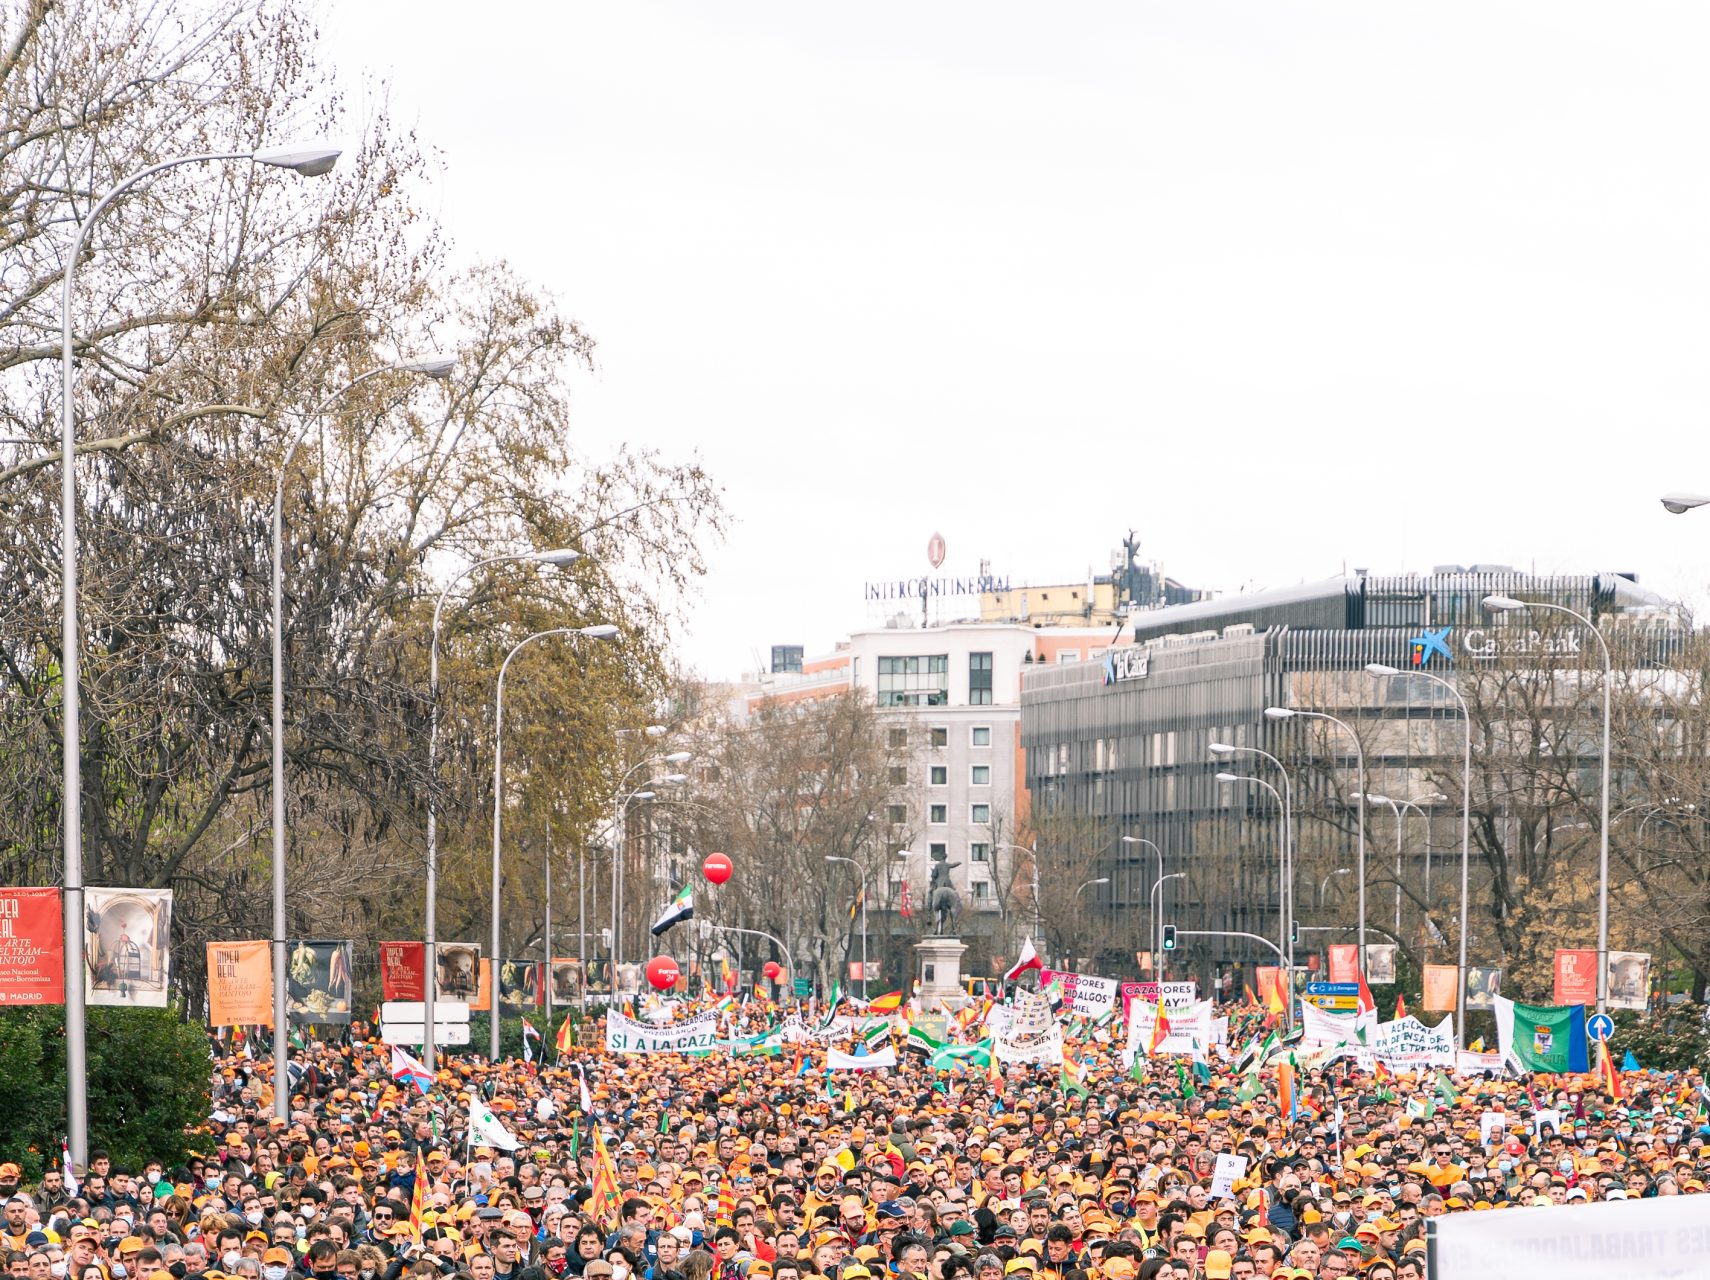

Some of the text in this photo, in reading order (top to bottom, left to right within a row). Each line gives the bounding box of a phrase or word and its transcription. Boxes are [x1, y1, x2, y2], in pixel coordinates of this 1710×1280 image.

[865, 576, 1011, 599] INTERCONTINENTAL
[4, 939, 31, 947] ARTE
[217, 965, 237, 978] REAL
[1052, 974, 1105, 989] CAZADORES
[1125, 986, 1191, 994] CAZADORES
[1062, 1003, 1090, 1013] AIMIEL
[676, 1012, 718, 1028] CAZADORES
[636, 1038, 646, 1051] A
[652, 1039, 671, 1050] LA
[677, 1033, 718, 1049] CAZA
